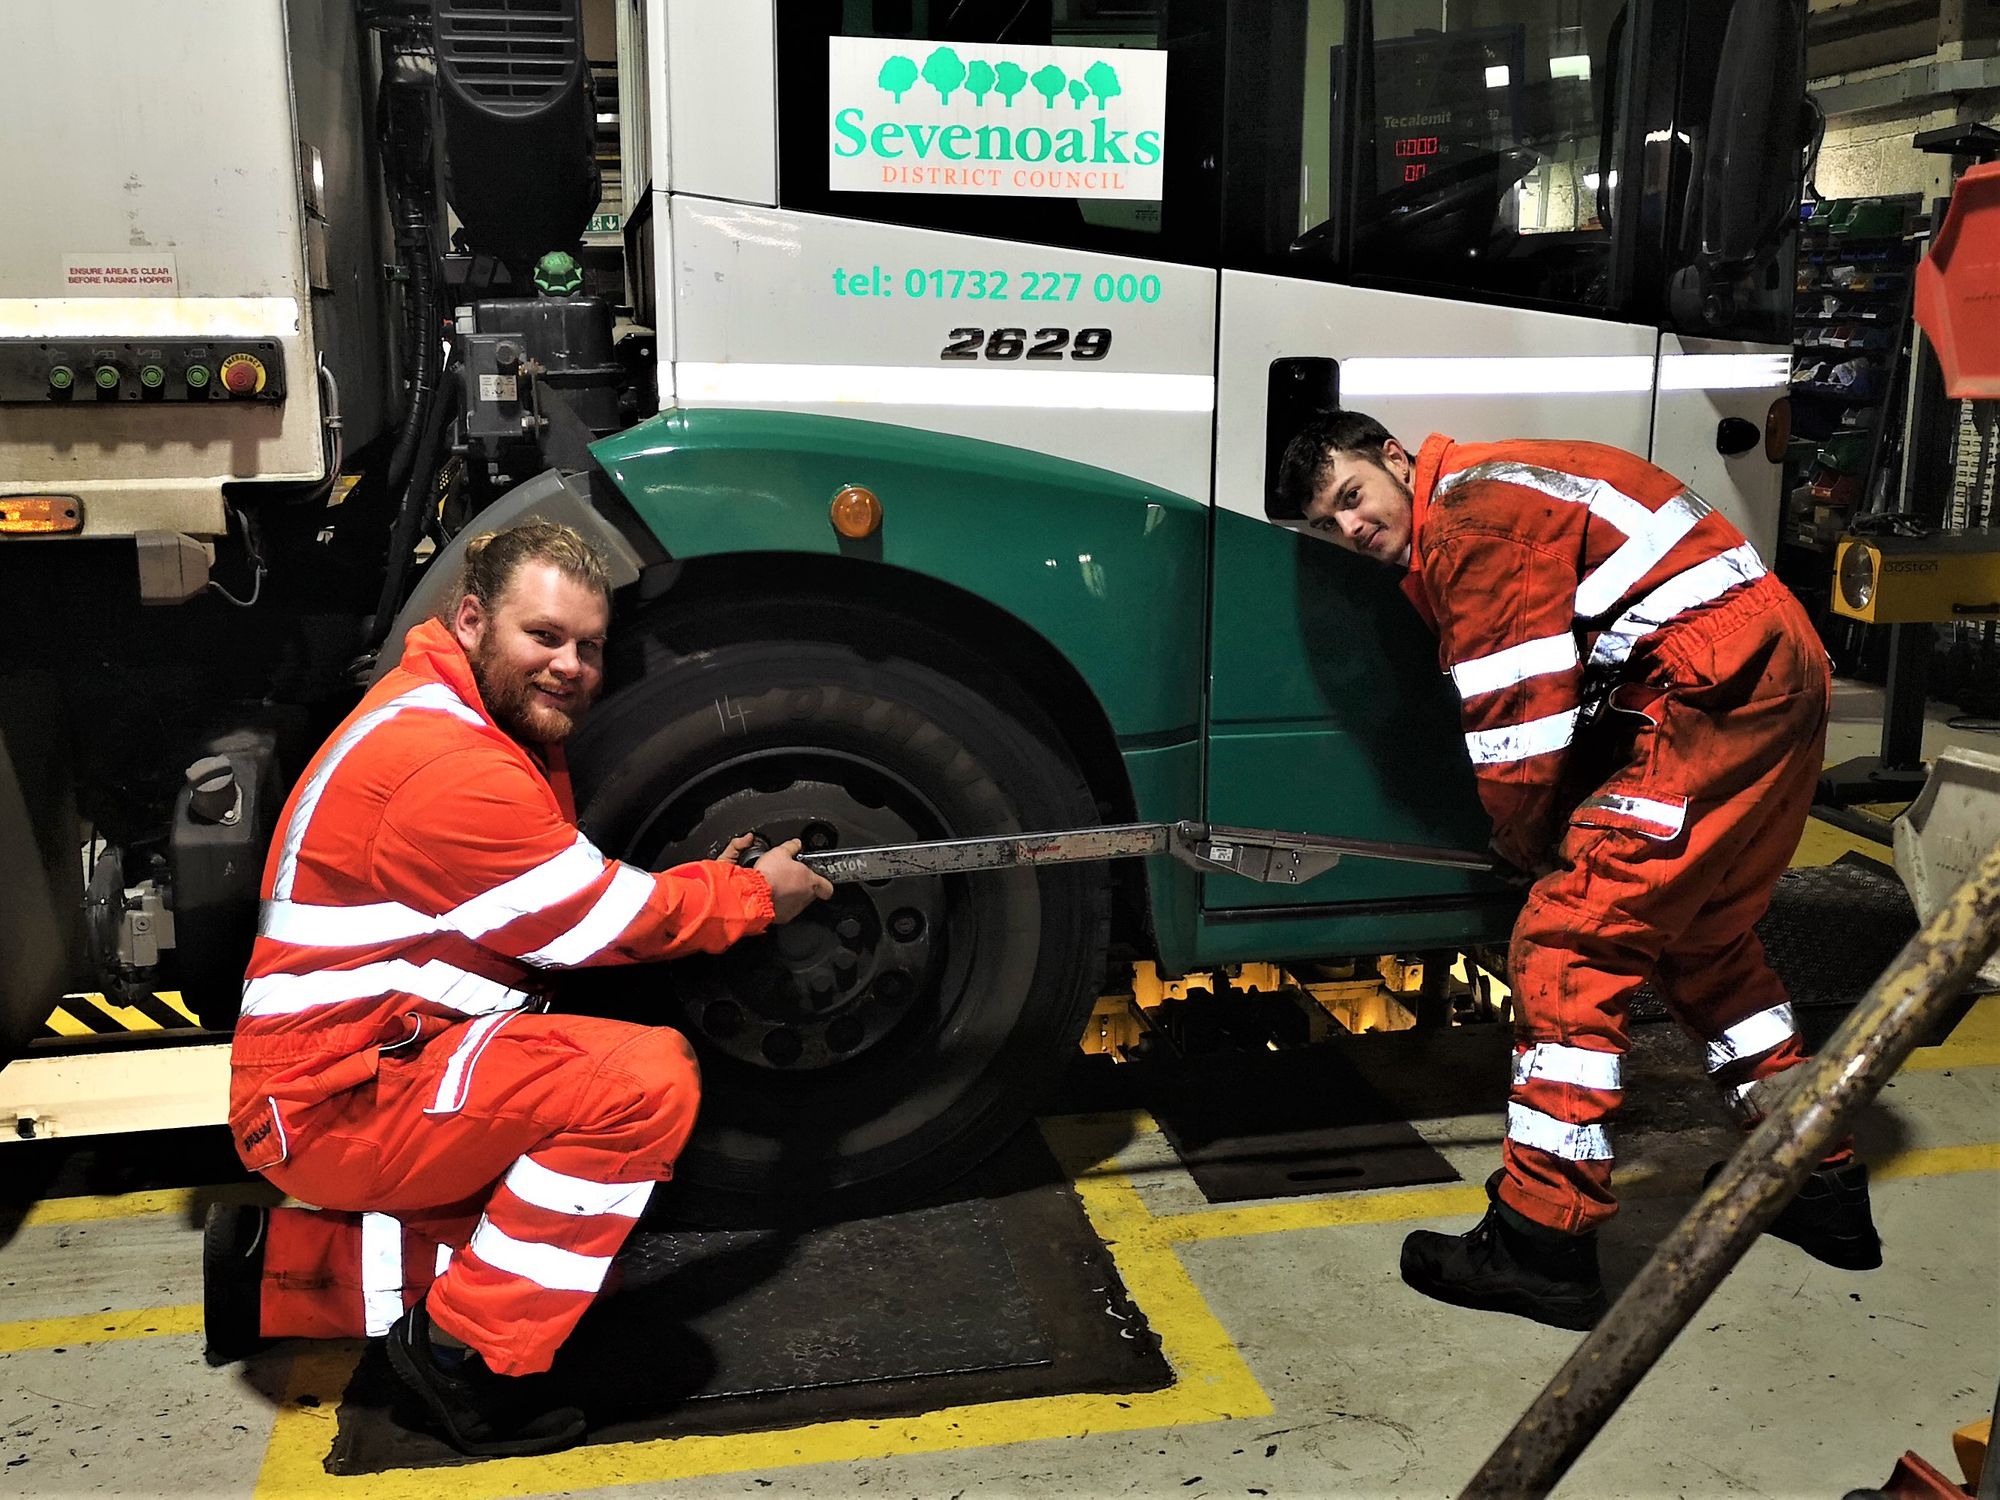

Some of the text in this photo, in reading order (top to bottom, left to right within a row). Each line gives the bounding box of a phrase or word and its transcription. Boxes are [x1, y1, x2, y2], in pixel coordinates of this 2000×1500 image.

[834, 108, 1160, 166] Sevenoaks
[1384, 112, 1452, 129] Tecalemit
[882, 166, 1125, 189] DISTRICT COUNCIL
[833, 266, 1161, 303] tel: 01732 227 000
[224, 354, 261, 368] EMERGENCY
[940, 327, 1113, 361] 2629
[715, 695, 752, 735] 14
